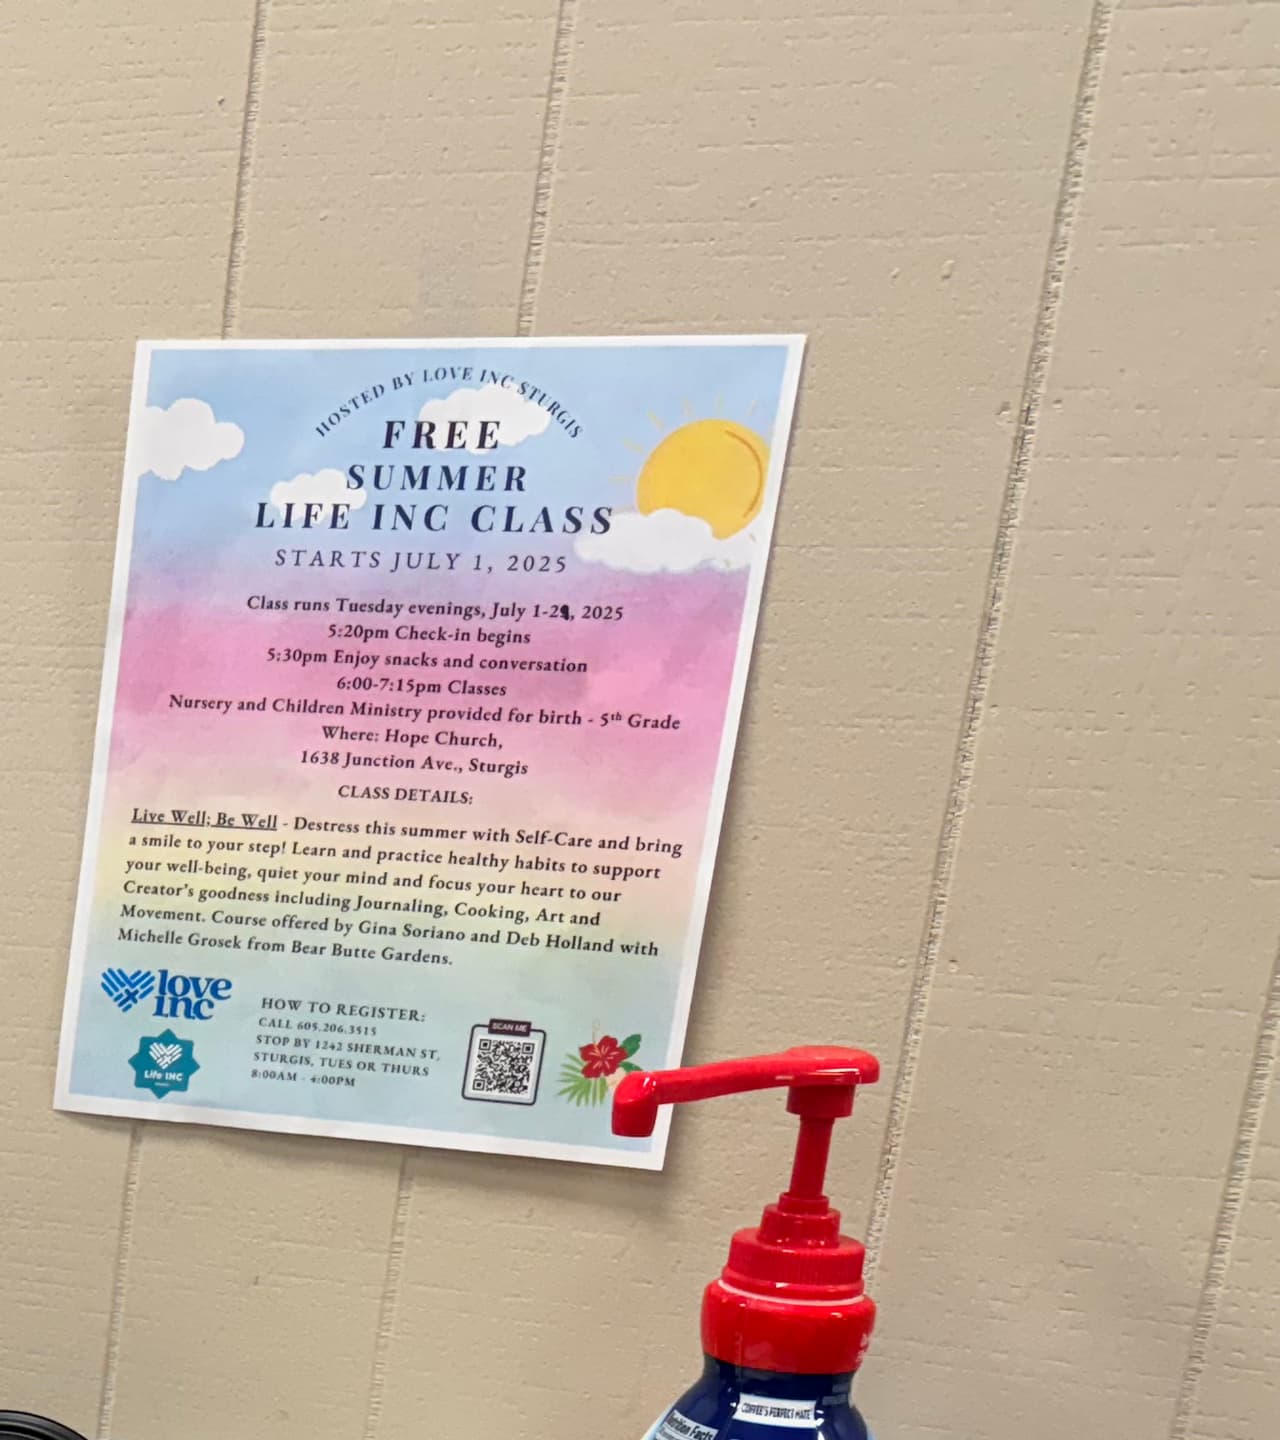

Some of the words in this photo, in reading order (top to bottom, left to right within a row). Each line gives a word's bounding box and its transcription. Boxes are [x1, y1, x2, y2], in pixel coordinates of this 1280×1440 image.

[315, 384, 385, 437] HOSTED
[392, 372, 415, 391] BY
[423, 366, 474, 383] LOVE
[479, 369, 514, 389] INC
[517, 381, 583, 439] STURGIS
[382, 420, 502, 449] FREE
[346, 464, 527, 492] SUMMER
[255, 502, 351, 530] LIFE
[371, 503, 449, 532] INC
[470, 504, 613, 535] CLASS
[274, 548, 381, 569] STARTS
[389, 551, 461, 573] JULY
[473, 554, 493, 574] 1,
[506, 554, 566, 573] 2025
[246, 595, 289, 611] Class
[293, 600, 330, 612] runs
[335, 597, 404, 619] Tuesday
[407, 601, 486, 622] evenings,
[488, 601, 527, 623] July
[581, 605, 624, 621] 2025
[328, 623, 389, 644] 5:20pm
[394, 624, 471, 642] Check-in
[476, 626, 531, 649] begins
[267, 647, 328, 668] 5:30pm
[333, 649, 381, 670] Enjoy
[384, 651, 438, 668] snacks
[442, 653, 475, 669] and
[479, 657, 588, 673] conversation
[336, 676, 442, 698] 6:00-7:15pm
[447, 679, 507, 697] Classes
[168, 693, 233, 715] Nursery
[237, 696, 267, 712] and
[271, 698, 345, 715] Children
[349, 701, 423, 723] Ministry
[426, 706, 503, 724] provided
[507, 707, 534, 723] for
[538, 708, 582, 726] birth
[627, 713, 681, 730] Grade
[321, 725, 379, 742] Where:
[384, 728, 430, 749] Hope
[434, 730, 503, 750] Church,
[301, 750, 340, 765] 1638
[341, 751, 415, 769] Junction
[420, 755, 463, 774] Ave.,
[468, 757, 529, 779] Sturgis
[337, 784, 390, 800] CLASS
[393, 787, 473, 805] DETAILS:
[130, 807, 166, 825] Live
[169, 809, 211, 829] Well;
[214, 813, 238, 830] Be
[239, 813, 278, 832] Well
[293, 816, 360, 834] Destress
[365, 819, 396, 836] this
[400, 826, 468, 840] summer
[472, 827, 510, 843] with
[514, 829, 593, 849] Self-Care
[597, 835, 631, 851] and
[635, 836, 683, 859] bring
[119, 903, 206, 923] Movement.
[211, 910, 267, 927] Course
[271, 913, 330, 931] offered
[333, 917, 353, 937] by
[358, 919, 397, 936] Gina
[401, 923, 466, 941] Soriano
[470, 929, 501, 944] and
[505, 930, 541, 947] Deb
[545, 933, 615, 953] Holland
[619, 941, 659, 957] with
[117, 927, 183, 945] Michelle
[187, 932, 242, 950] Grosek
[247, 935, 286, 953] from
[291, 939, 327, 956] Bear
[331, 942, 376, 960] Butte
[380, 946, 453, 966] Gardens.
[158, 969, 233, 1000] love
[258, 1017, 290, 1029] CALL
[261, 997, 303, 1011] HOW
[309, 1001, 331, 1014] TO
[336, 1003, 425, 1023] REGISTER:
[256, 1034, 290, 1047] STOP
[293, 1037, 311, 1049] BY
[347, 1042, 417, 1058] SHERMAN
[144, 1070, 162, 1080] Life
[165, 1072, 183, 1081] INC
[253, 1051, 314, 1067] STURGIS,
[320, 1057, 353, 1070] TUES
[356, 1061, 376, 1072] OR
[381, 1062, 429, 1077] THURS
